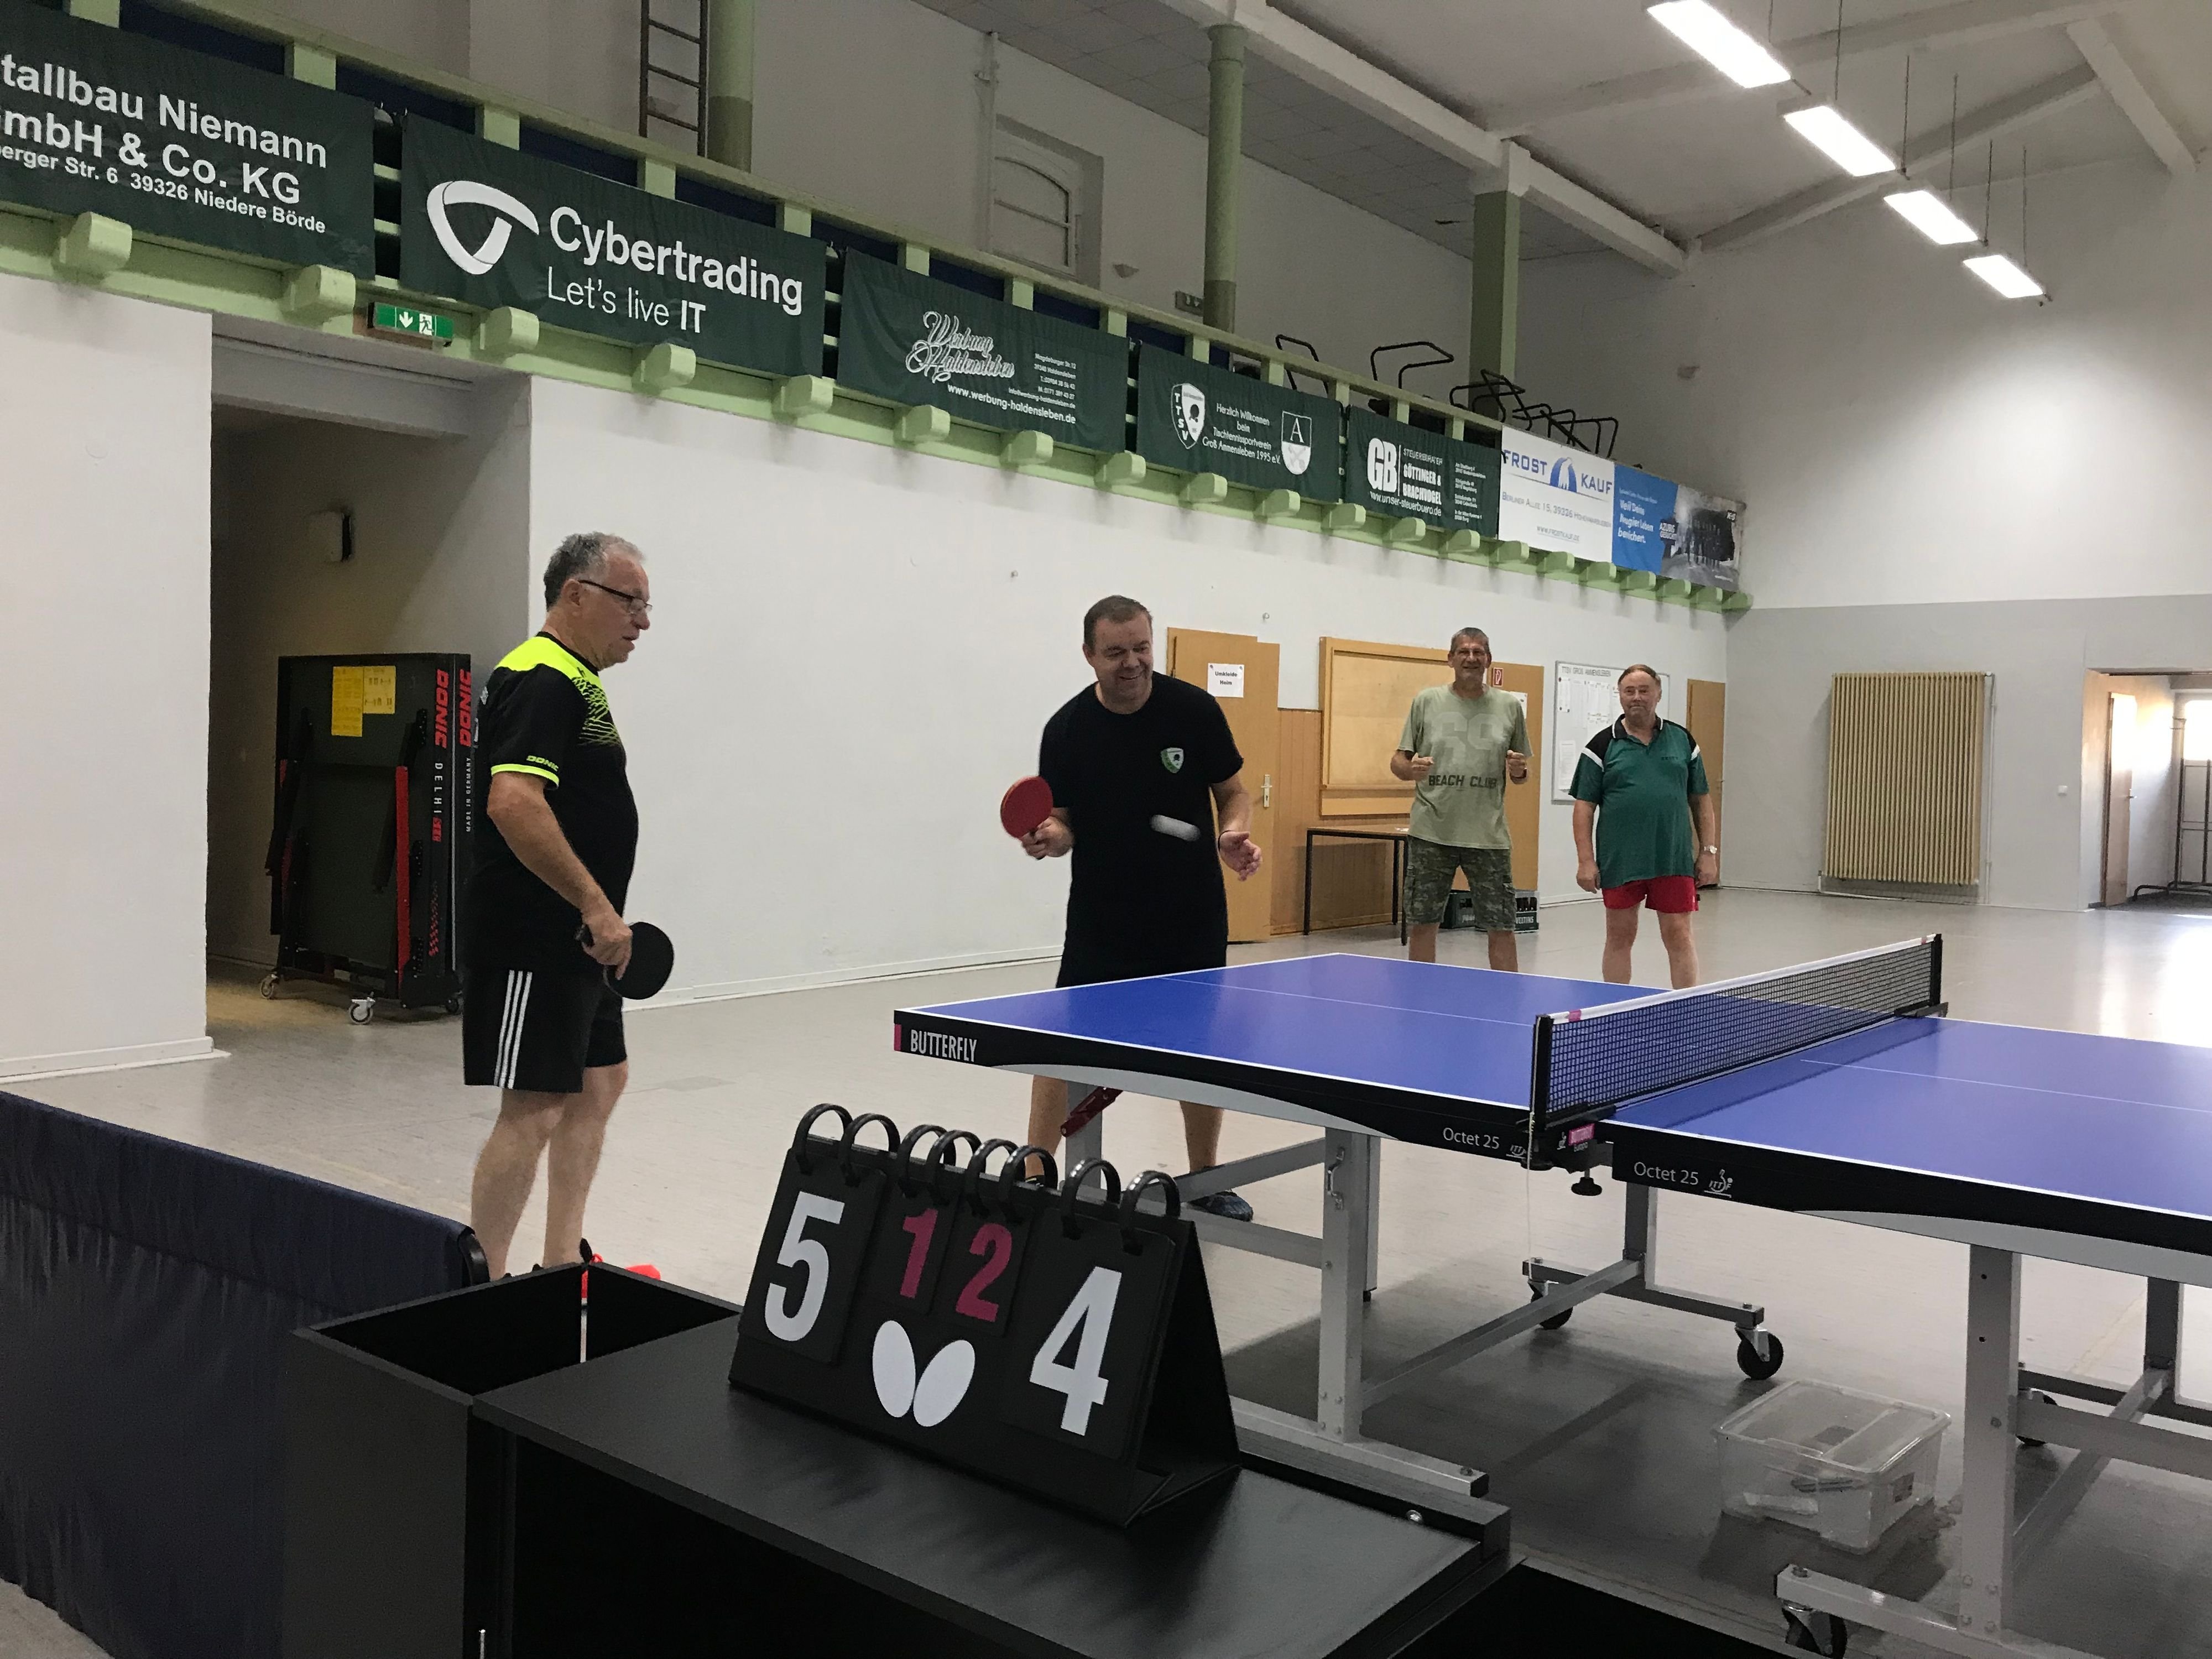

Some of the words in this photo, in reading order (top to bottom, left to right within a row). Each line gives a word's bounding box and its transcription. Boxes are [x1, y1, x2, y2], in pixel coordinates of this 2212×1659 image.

[1, 54, 143, 119] tallbau
[159, 94, 326, 168] Niemann
[0, 109, 102, 157] mbH
[119, 132, 148, 169] &
[162, 144, 227, 189] Co.
[242, 162, 299, 204] KG
[0, 145, 59, 169] erger
[65, 156, 98, 180] Str.
[107, 168, 118, 184] 6
[130, 173, 188, 201] 39326
[194, 189, 267, 219] Niedere
[272, 205, 326, 234] Börde
[550, 206, 803, 317] Cybertrading
[628, 288, 670, 326] live
[681, 299, 706, 333] IT
[923, 311, 994, 358] Werbung
[905, 340, 1015, 384] Haldensleben
[947, 383, 1076, 424] www.werbung-haldensleben.de
[1217, 403, 1239, 418] Herzlich
[1240, 409, 1270, 426] Willkommen
[1202, 436, 1218, 449] Groß
[1218, 440, 1255, 458] Ammensleben
[1256, 450, 1271, 462] 1995
[1213, 426, 1272, 451] Tischtennissportverein
[1237, 420, 1250, 433] beim
[1290, 418, 1304, 443] A
[1367, 437, 1397, 493] GB
[1404, 462, 1437, 486] GÖTTINGER
[1437, 474, 1442, 487] &
[1504, 449, 1548, 476] FROST
[1580, 472, 1613, 494] KAUF
[1402, 482, 1442, 505] BRACHVOGEL
[435, 667, 449, 749] DONIC
[460, 668, 472, 748] DONIC
[434, 762, 443, 813] DELHI
[466, 799, 471, 807] IN
[1428, 775, 1465, 786] BEACH
[1469, 775, 1498, 789] CLUB
[910, 1029, 978, 1063] BUTTERFLY
[1443, 1127, 1480, 1147] Octet
[1483, 1134, 1500, 1150] 25
[1634, 1161, 1676, 1182] Octet
[1679, 1169, 1699, 1186] 25
[764, 1191, 845, 1342] 5
[902, 1208, 939, 1298] 1
[956, 1222, 1013, 1323] 2
[1029, 1266, 1122, 1437] 4
